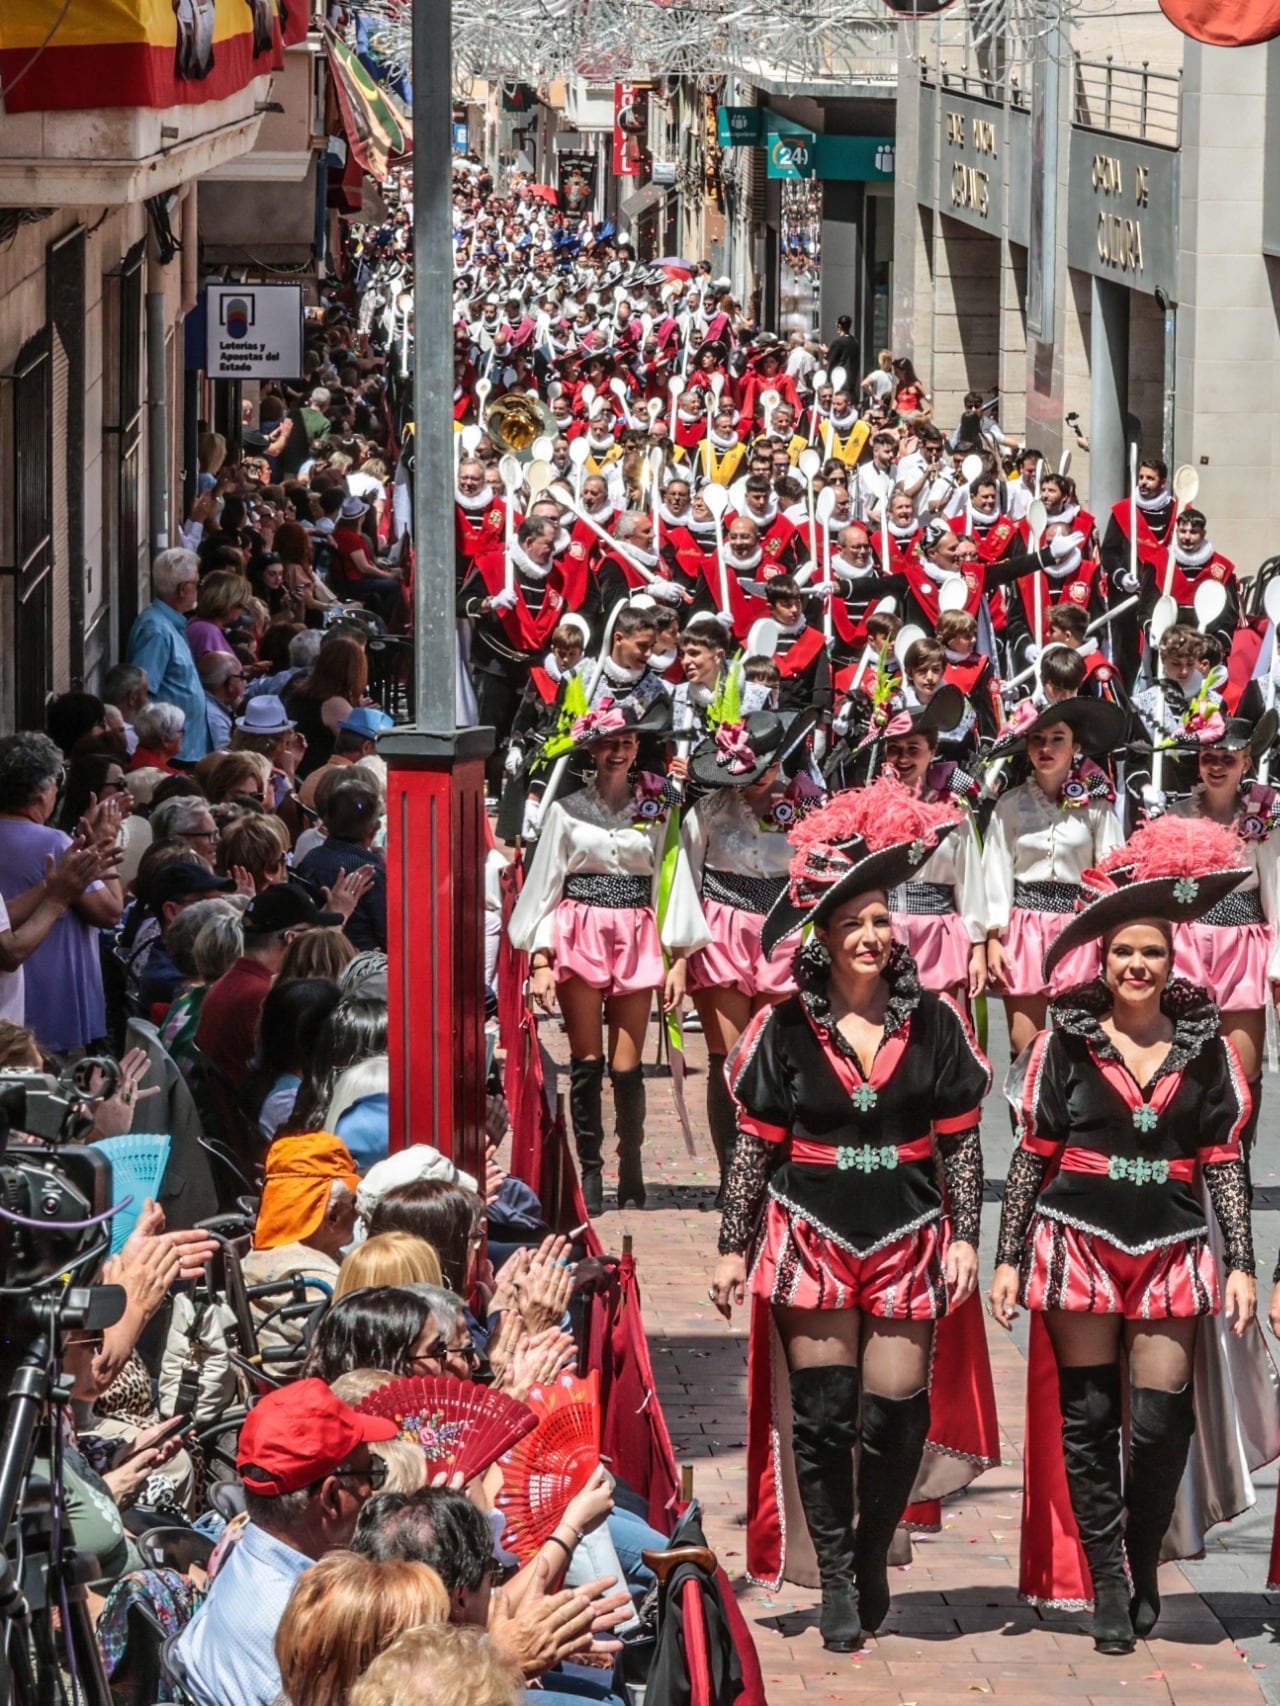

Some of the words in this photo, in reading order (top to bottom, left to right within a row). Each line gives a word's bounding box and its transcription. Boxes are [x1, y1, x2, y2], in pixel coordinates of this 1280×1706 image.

[1097, 210, 1144, 270] CULTURA
[220, 341, 258, 350] Loterías
[260, 343, 265, 352] y
[220, 352, 263, 362] Apuestas
[265, 352, 280, 360] del
[220, 362, 252, 371] Estado
